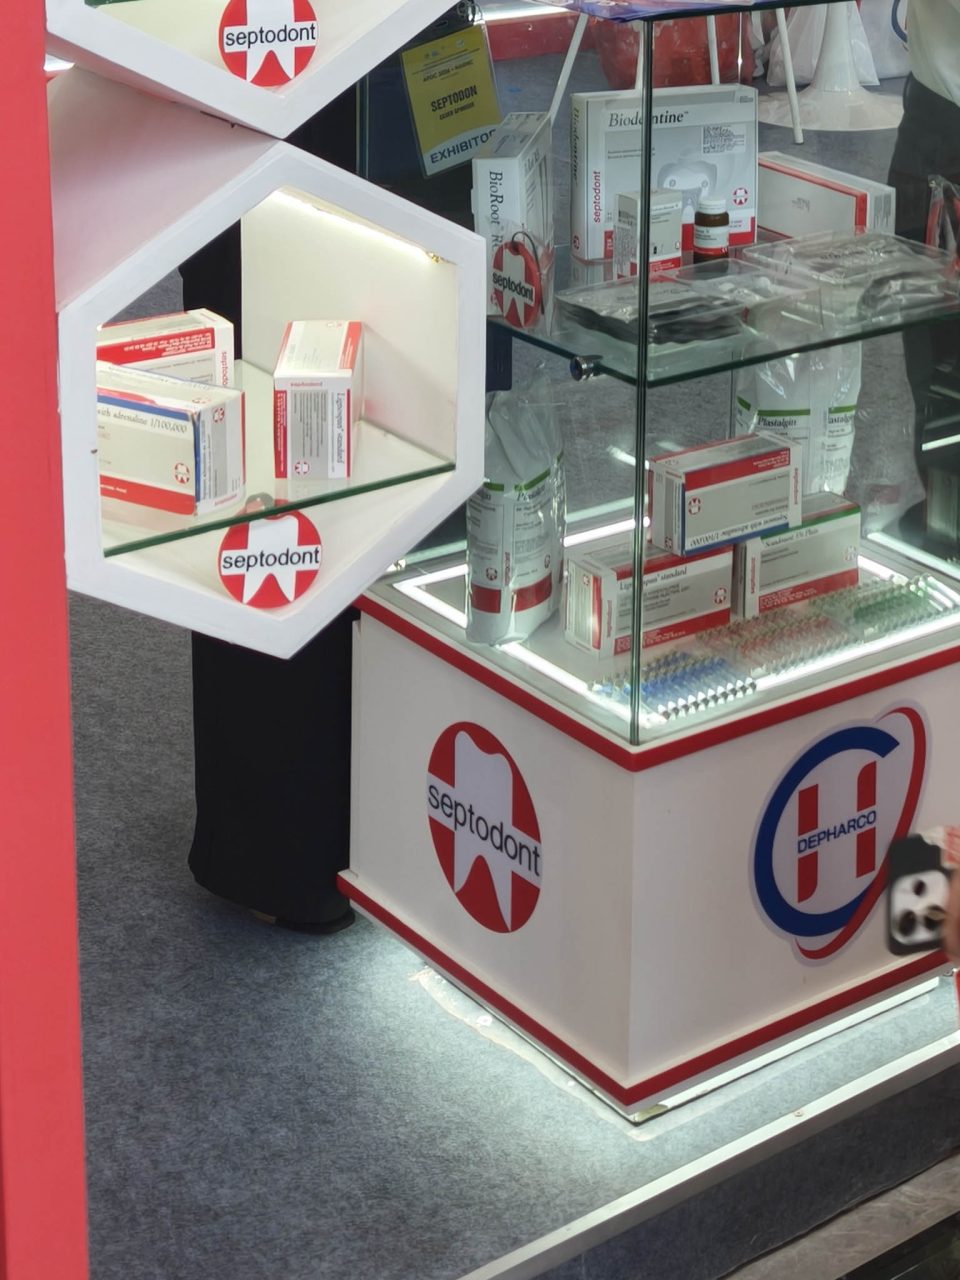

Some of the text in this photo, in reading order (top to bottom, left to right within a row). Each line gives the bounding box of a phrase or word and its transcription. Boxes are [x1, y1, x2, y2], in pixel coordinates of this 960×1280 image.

[225, 23, 316, 49] septodont
[489, 171, 504, 225] BioRoot
[593, 171, 602, 223] septodont
[491, 271, 534, 301] septodont
[221, 351, 229, 388] septodo
[222, 545, 320, 572] septodont
[427, 783, 541, 878] septodont
[796, 810, 877, 855] DEPHARCO
